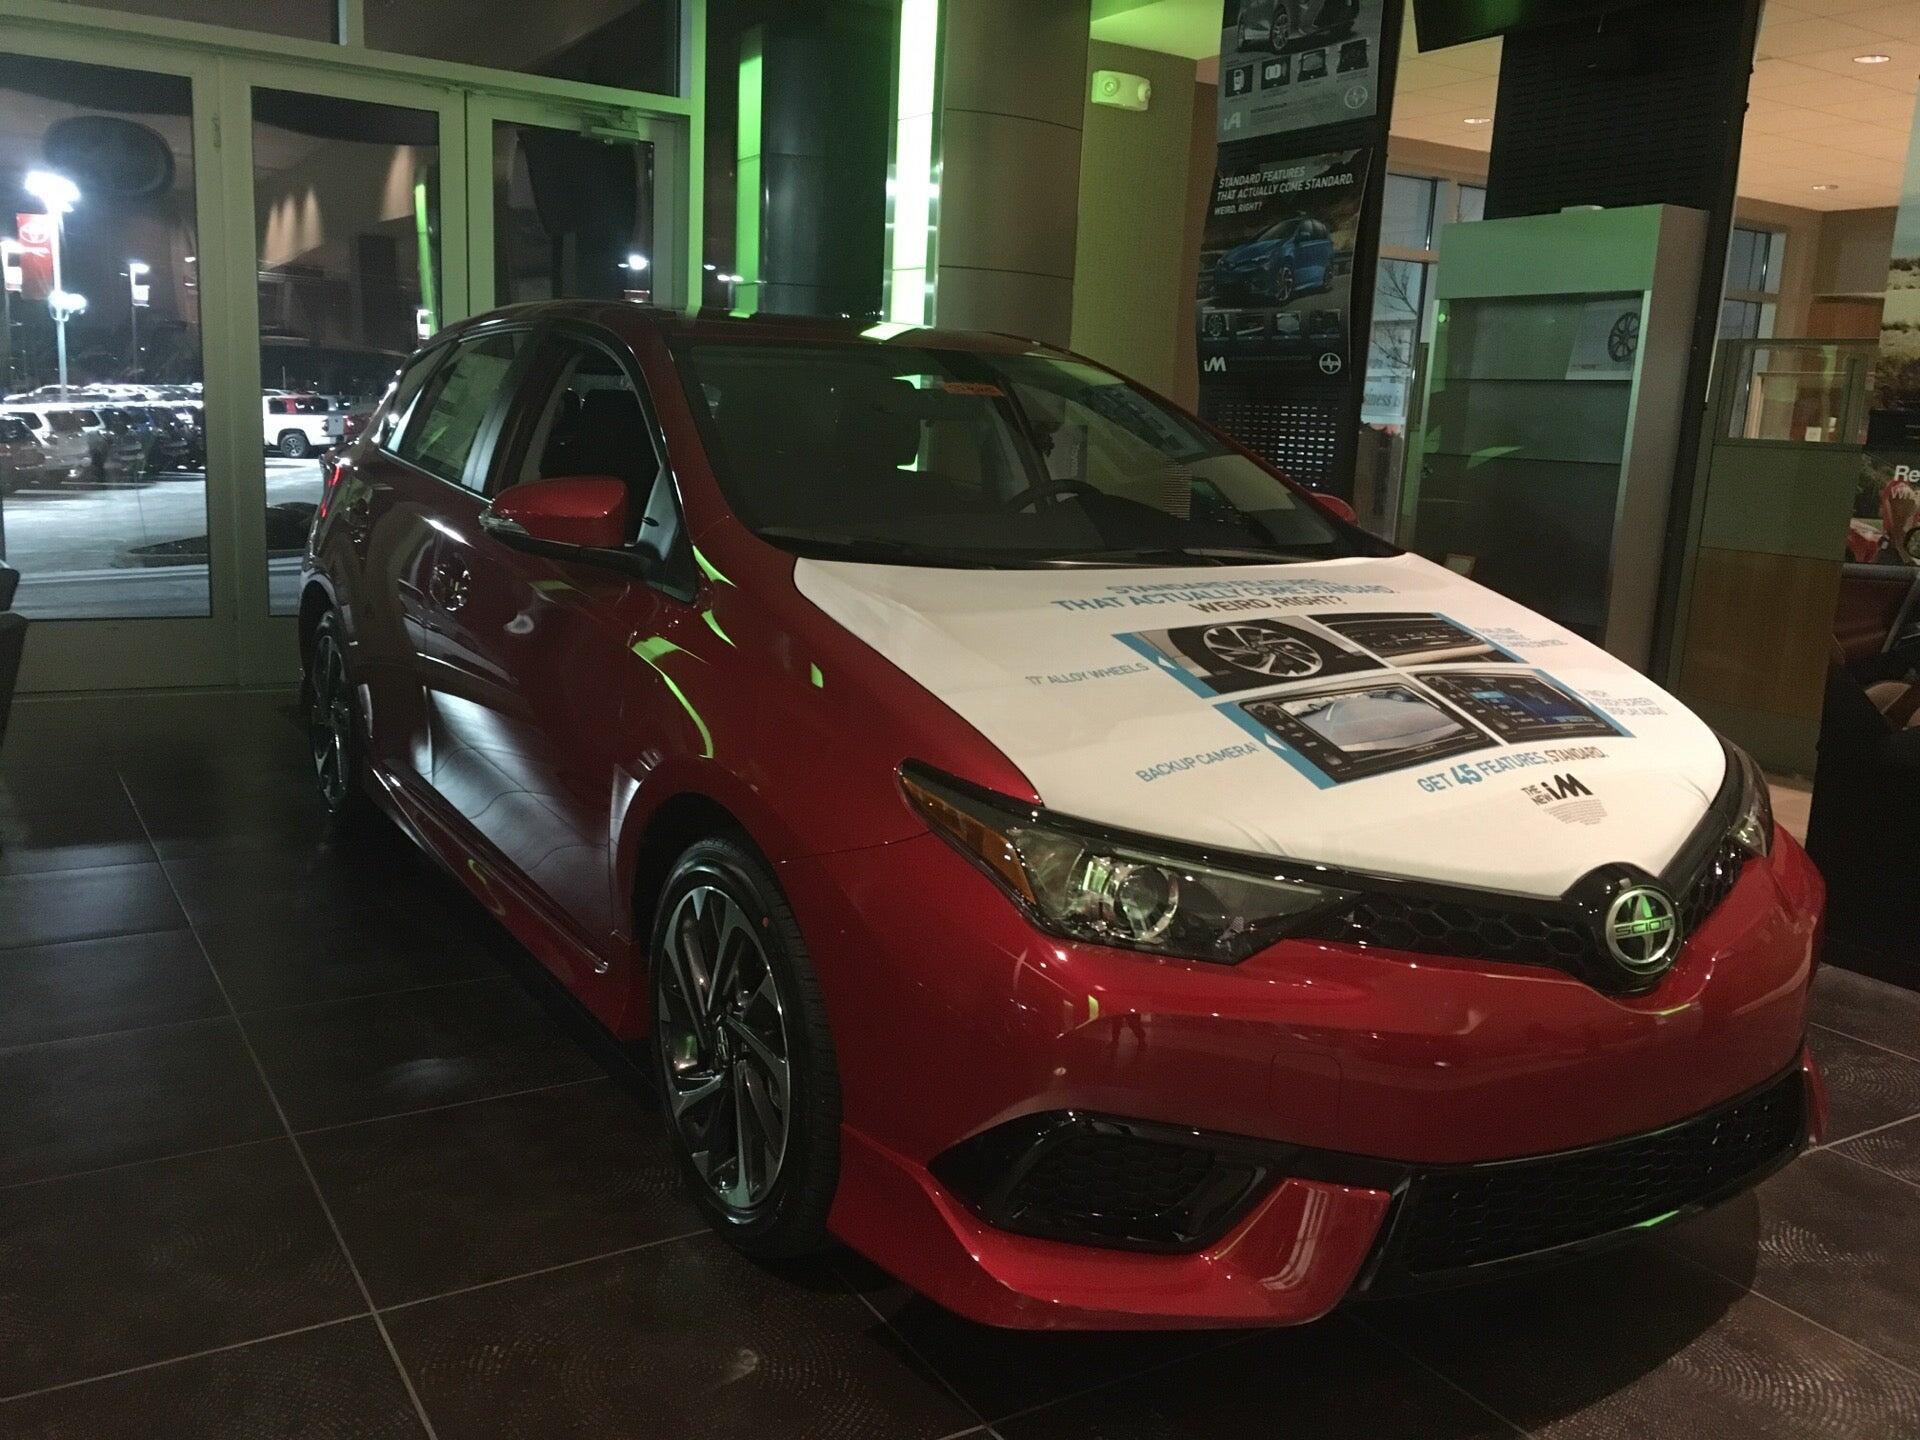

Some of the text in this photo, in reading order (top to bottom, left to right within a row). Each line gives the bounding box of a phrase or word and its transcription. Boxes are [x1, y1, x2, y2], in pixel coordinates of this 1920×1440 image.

[1215, 172, 1354, 202] THAT ACTUALLY COME STANDARD.
[1218, 165, 1306, 189] STANDARD FEATURES
[1238, 201, 1262, 213] RIGHT?
[1049, 597, 1125, 611] THAT
[1128, 587, 1245, 606] ACTUALLY
[1271, 594, 1349, 607] RIGHT?
[1047, 671, 1089, 685] ALLOY
[1088, 662, 1149, 680] WHEELS
[1135, 757, 1197, 783] BACKUP
[1417, 746, 1609, 793] GET 45 FEATURES, STANDARD.
[1521, 784, 1542, 798] THE
[1532, 794, 1553, 806] NEW
